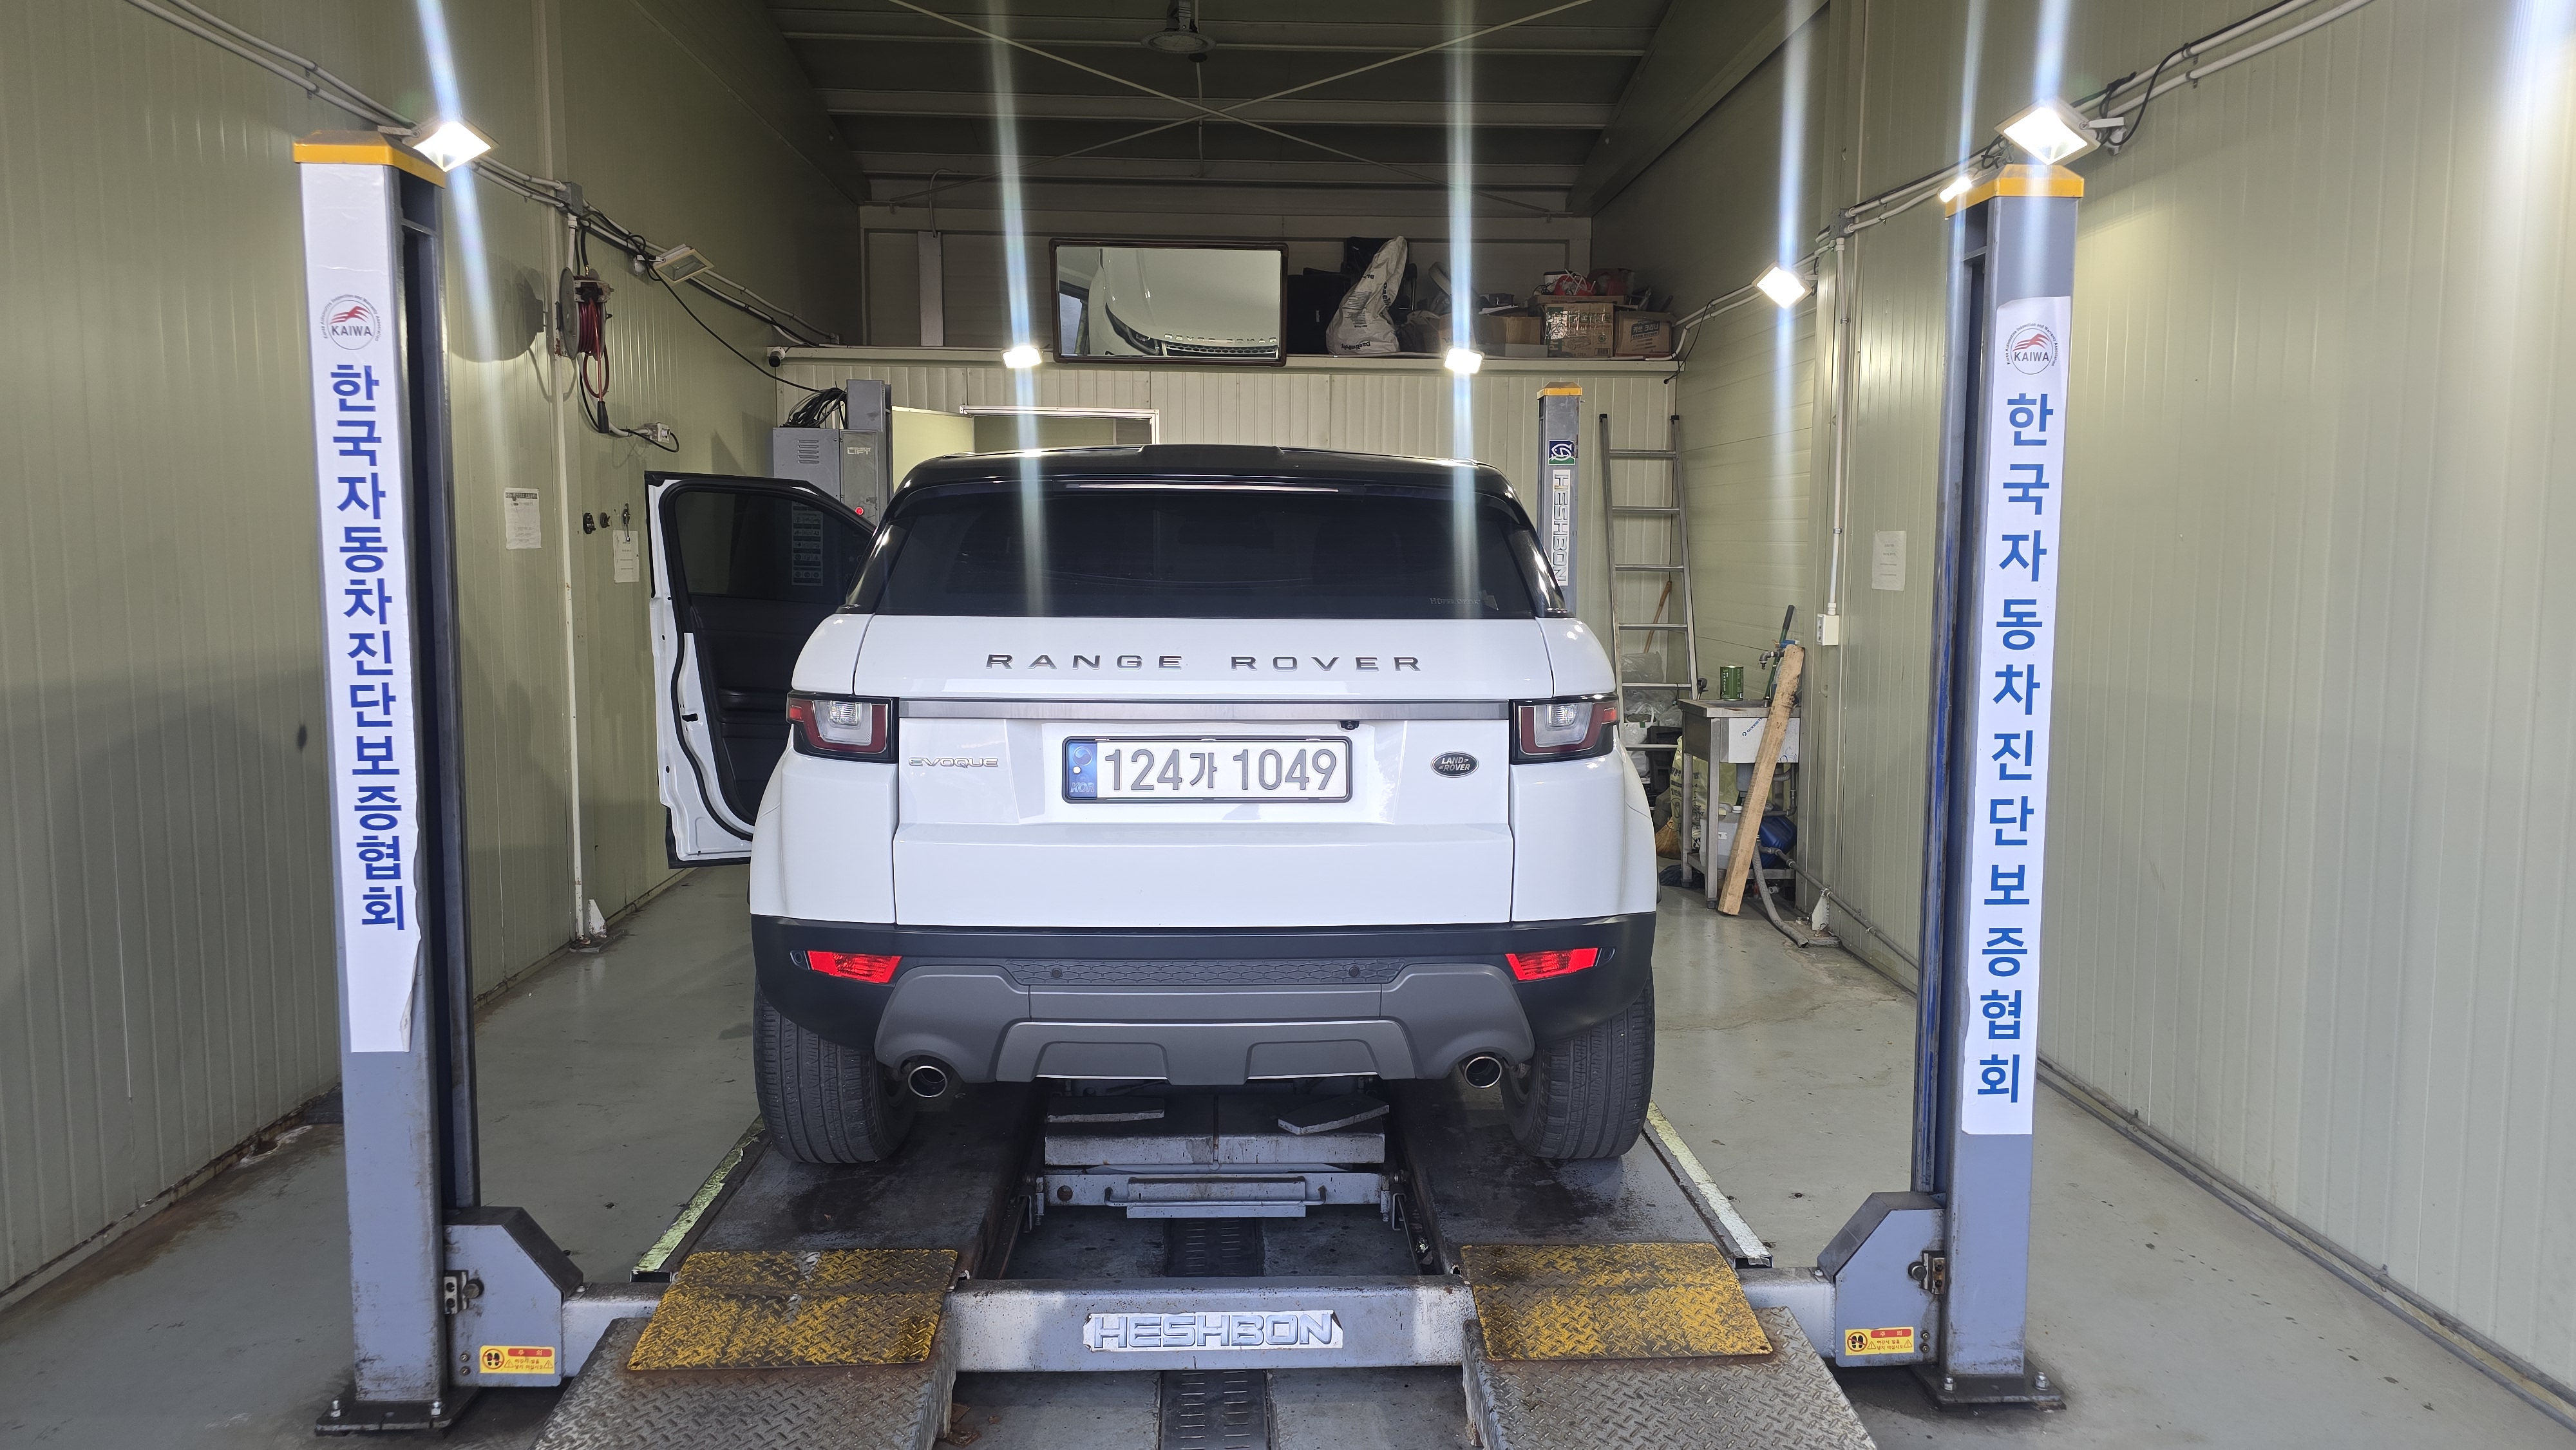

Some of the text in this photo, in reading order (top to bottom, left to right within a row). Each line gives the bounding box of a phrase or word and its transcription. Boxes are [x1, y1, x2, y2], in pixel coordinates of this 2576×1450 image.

[331, 325, 373, 337] KAIWA
[2014, 352, 2049, 361] KAIWA
[1552, 474, 1569, 581] HESHBON
[330, 364, 405, 930] 한국자동차진단보증협회
[985, 654, 1421, 672] RANGE ROVER
[1977, 393, 2054, 1103] 한국자동차진단보증협회
[909, 757, 998, 768] EVOQUE
[1104, 748, 1338, 791] 124가 1049
[1070, 782, 1095, 793] KOR
[1094, 1313, 1333, 1348] HESHBON
